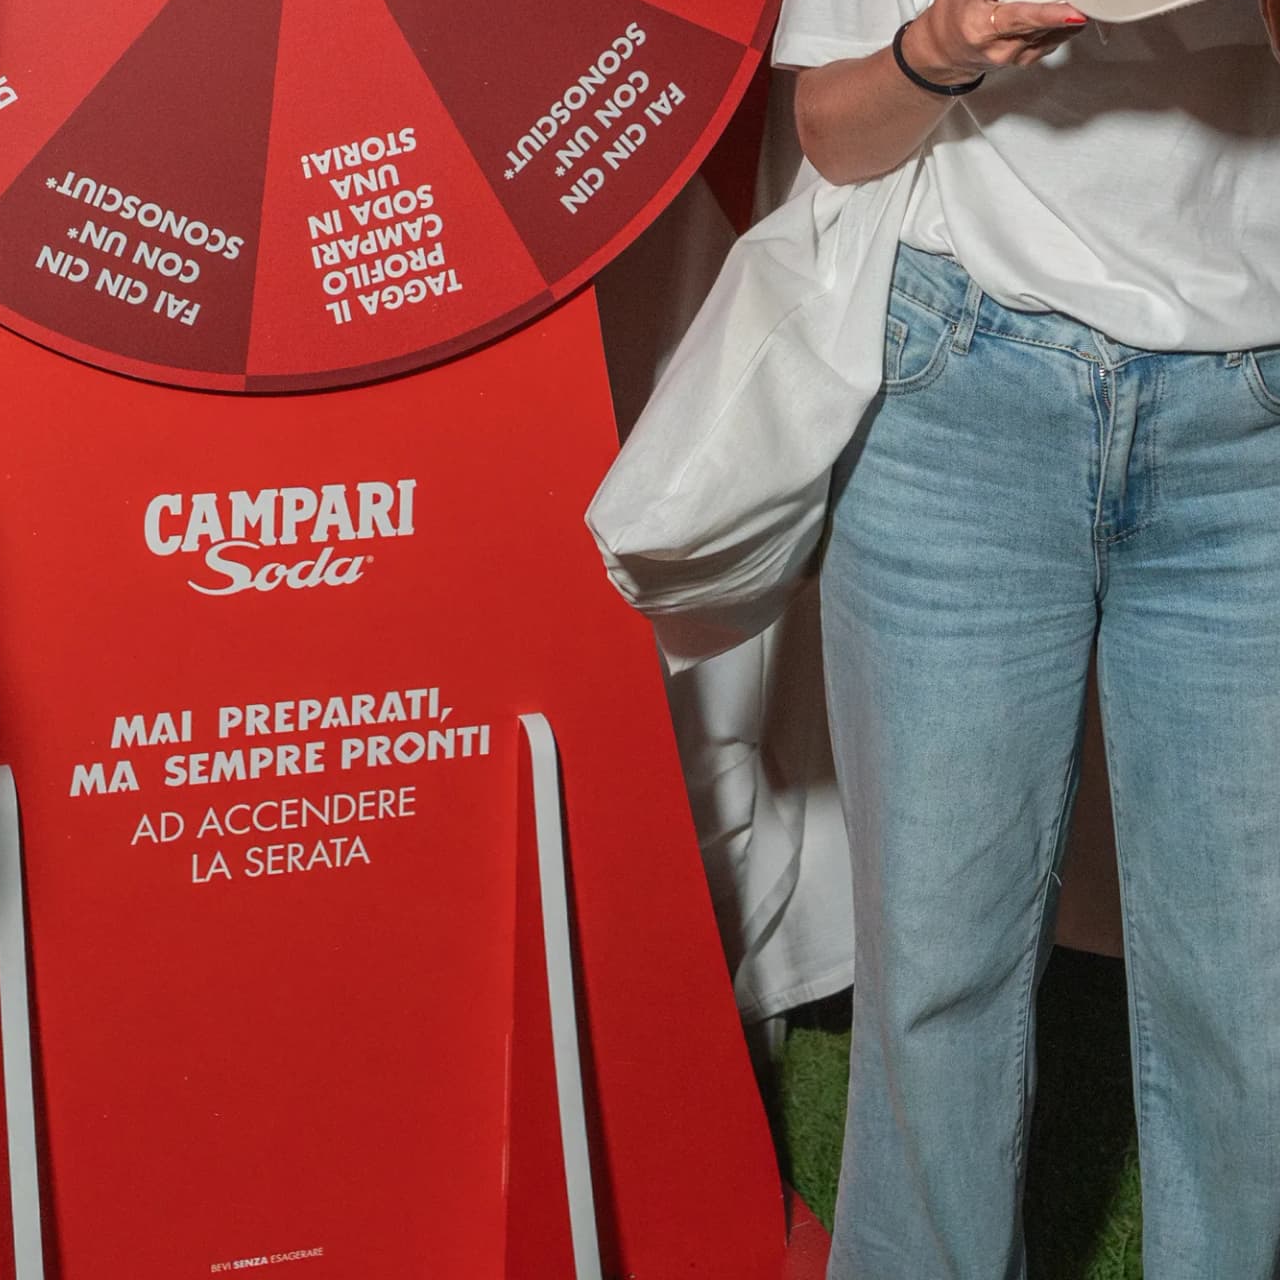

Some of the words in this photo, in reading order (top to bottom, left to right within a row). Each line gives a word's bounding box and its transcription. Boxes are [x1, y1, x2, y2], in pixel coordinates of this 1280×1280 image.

[595, 71, 649, 128] CON
[644, 83, 685, 125] FAI
[301, 128, 416, 178] STORIA!
[603, 124, 646, 169] CIN
[330, 164, 399, 199] UNA
[560, 168, 604, 213] CIN
[308, 210, 342, 238] IN
[350, 185, 433, 225] SODA
[36, 245, 89, 282] CIN
[133, 241, 200, 283] CON
[312, 214, 442, 268] CAMPARI
[95, 268, 148, 304] CIN
[323, 243, 444, 294] PROFILO
[154, 291, 200, 325] FAI
[326, 300, 351, 323] IL
[359, 270, 462, 314] TAGGA
[144, 479, 416, 556] CAMPARI
[187, 540, 365, 596] Soda
[110, 711, 192, 749] MAI
[219, 688, 453, 738] PREPARATI,
[69, 760, 140, 797] MA
[164, 742, 325, 788] SEMPRE
[341, 725, 491, 770] PRONTI
[130, 812, 185, 846] AD
[197, 787, 417, 839] ACCENDERE
[192, 851, 232, 883] LA
[244, 836, 371, 878] SERATA
[210, 1263, 232, 1273] BEVI
[233, 1256, 269, 1270] SENZA
[270, 1247, 324, 1264] ESAGERARE
